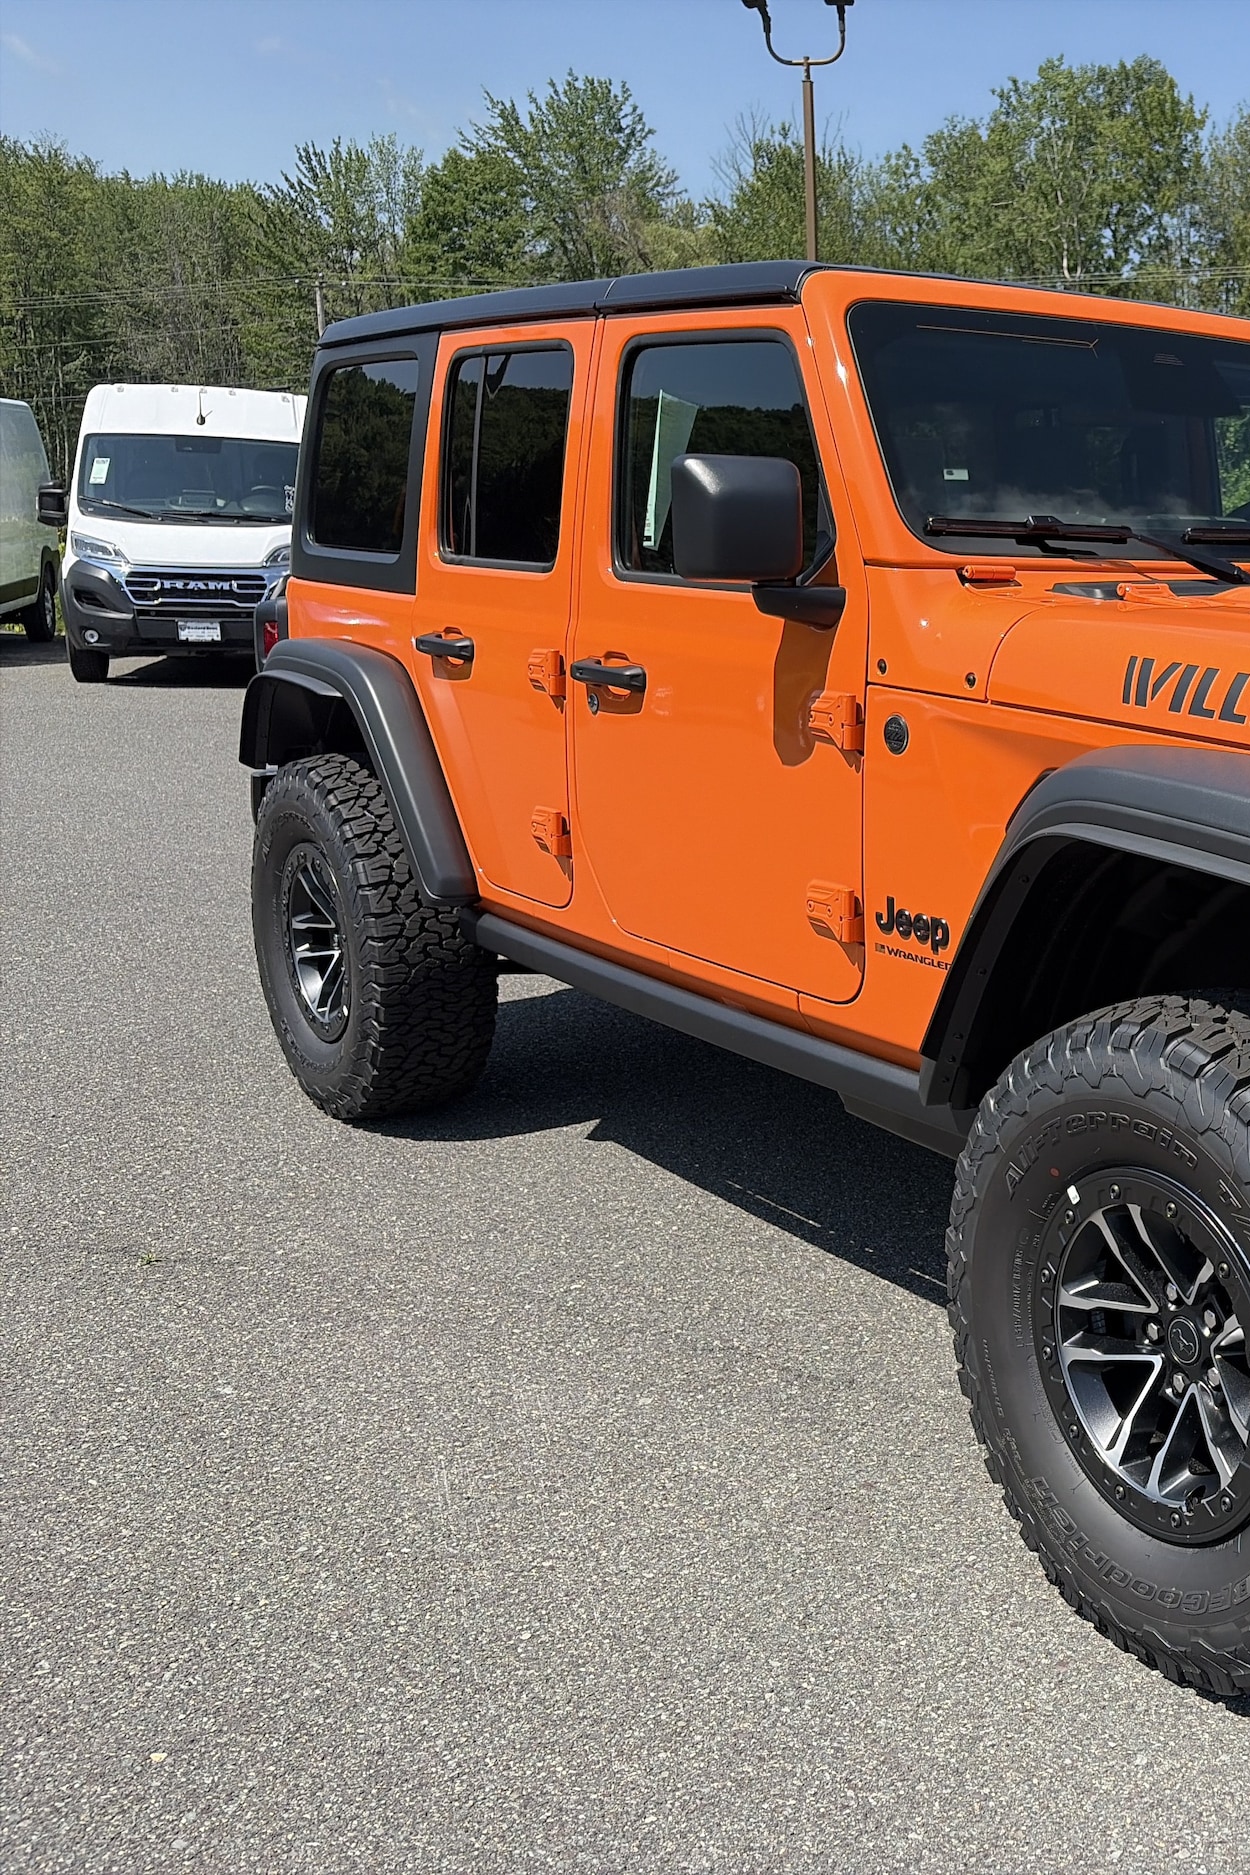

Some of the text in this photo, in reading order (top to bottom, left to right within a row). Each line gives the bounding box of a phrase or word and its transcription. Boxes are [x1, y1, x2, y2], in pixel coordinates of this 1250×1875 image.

[161, 580, 230, 590] RAM
[875, 895, 950, 956] Jeep
[1004, 1110, 1199, 1200] All-Terrain
